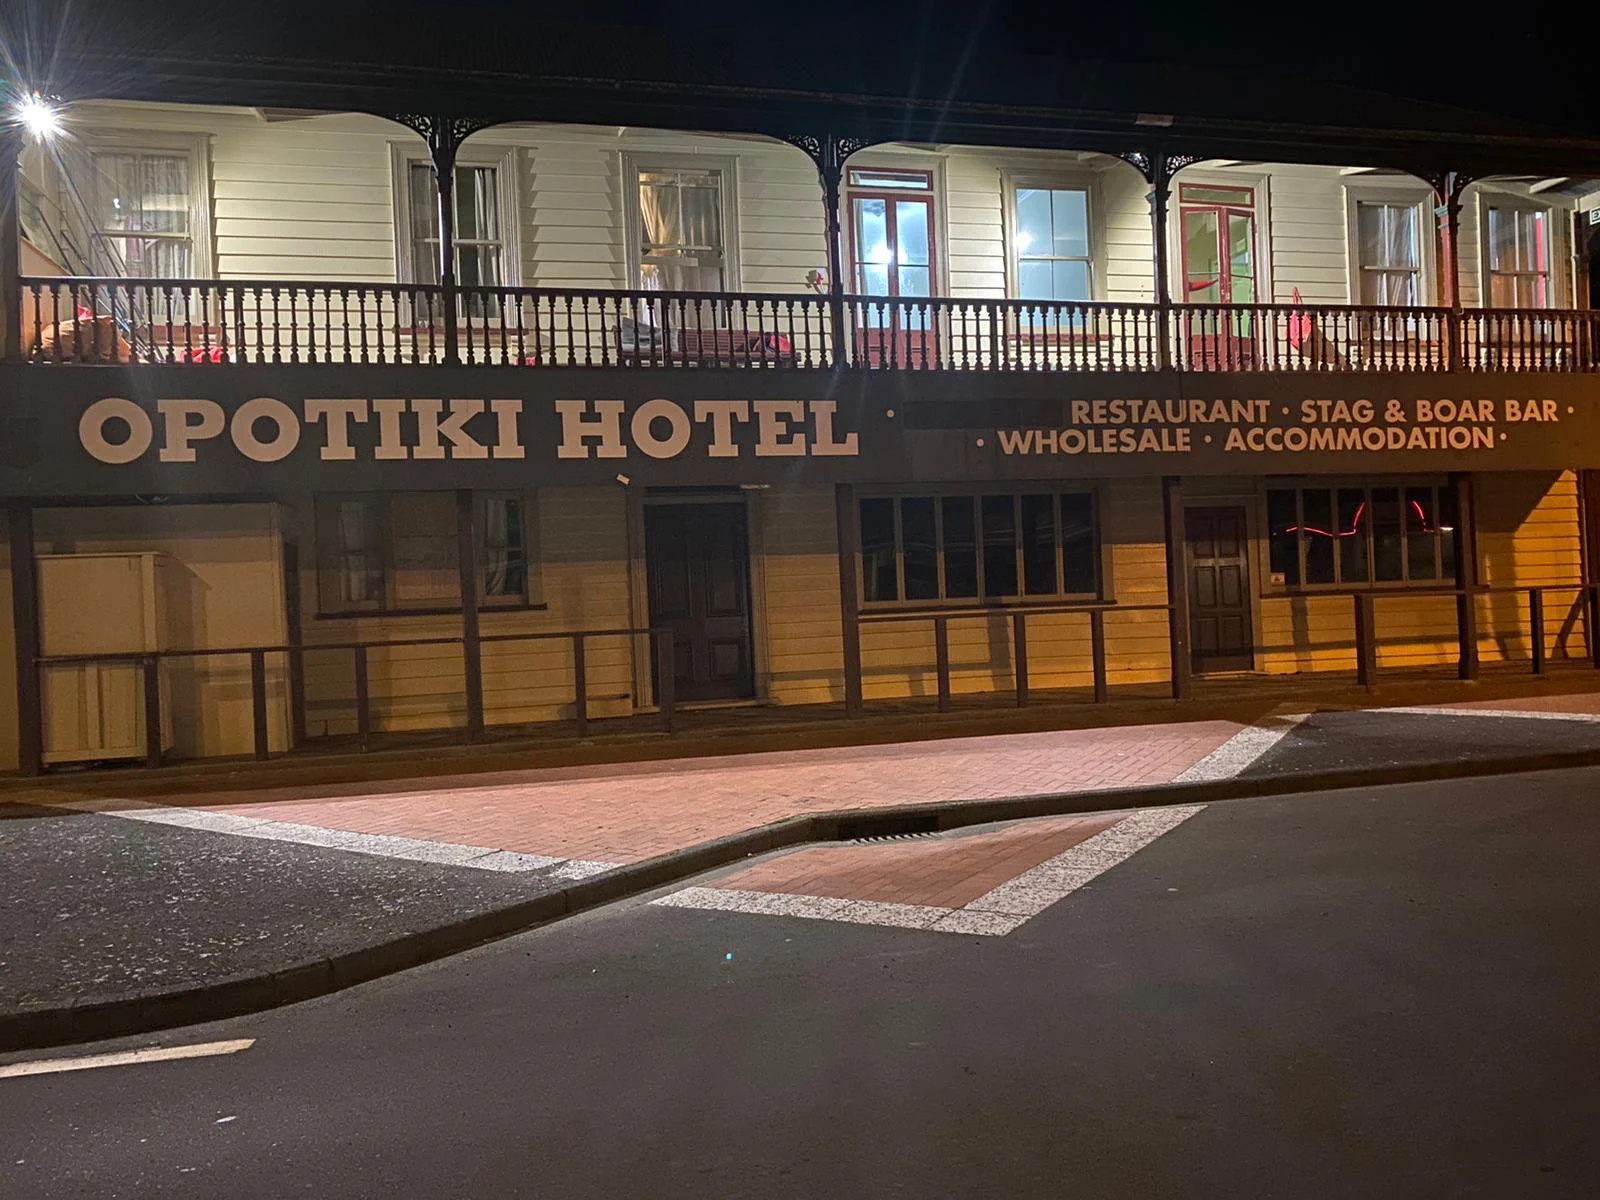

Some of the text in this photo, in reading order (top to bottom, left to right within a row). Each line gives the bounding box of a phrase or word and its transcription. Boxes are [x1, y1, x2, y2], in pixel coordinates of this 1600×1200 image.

[1071, 398, 1558, 424] RESTAURANT STAG & BOAR BAR
[79, 397, 858, 463] OPOTIKI HOTEL
[998, 425, 1495, 455] WHOLESALE ACCOMMODATION
